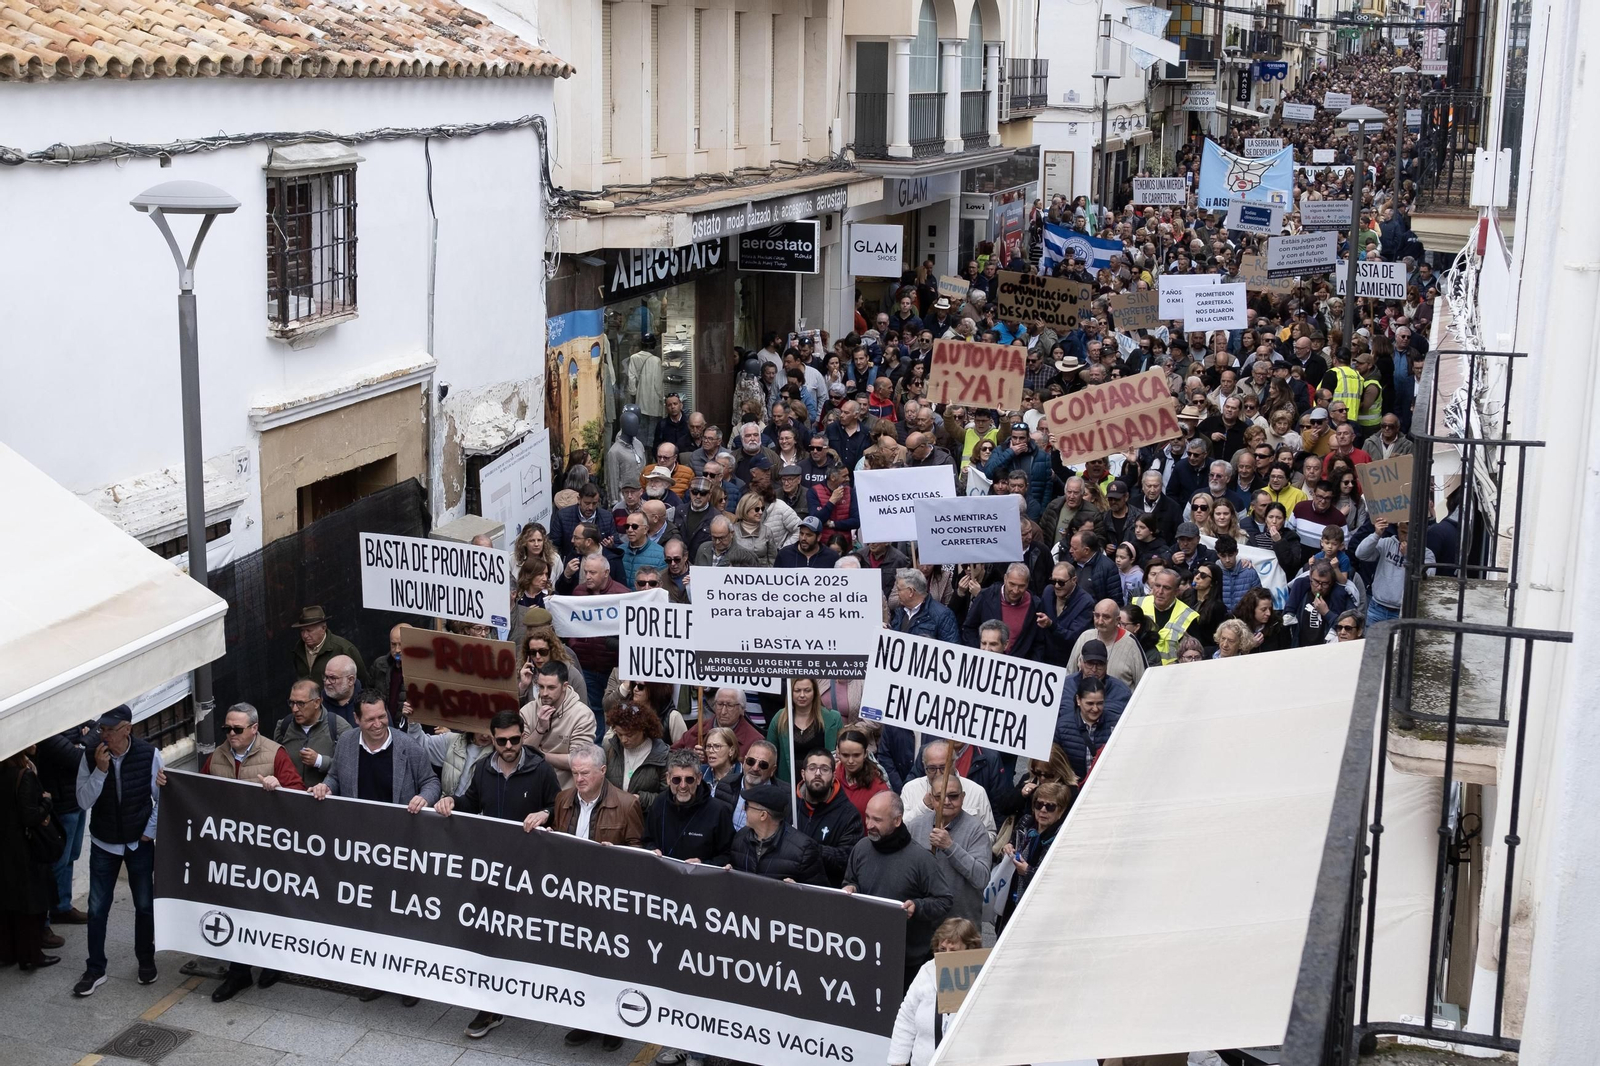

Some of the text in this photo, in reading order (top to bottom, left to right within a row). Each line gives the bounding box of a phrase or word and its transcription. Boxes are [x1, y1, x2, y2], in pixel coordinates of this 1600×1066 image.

[1189, 96, 1210, 106] NIEVES
[899, 176, 928, 207] GLAM
[1156, 180, 1165, 190] UNA
[1142, 193, 1177, 203] DE CARRETERAS
[727, 212, 744, 230] moda
[747, 207, 770, 226] calzado
[772, 206, 779, 222] &
[781, 200, 812, 216] accesorios
[816, 188, 847, 210] aerostato
[742, 238, 812, 251] aerostato
[854, 240, 897, 254] GLAM
[1301, 236, 1326, 244] jugando
[1356, 263, 1394, 279] ASTA DE
[1019, 274, 1046, 288] SIN
[1339, 280, 1404, 298] ALAMIENTO
[1014, 295, 1060, 312] NO HAY
[1128, 293, 1149, 305] SIN
[1000, 306, 1076, 327] DESARROLLO
[1113, 306, 1159, 318] CARRETER
[1122, 316, 1138, 326] DEL
[1050, 376, 1170, 424] COMARCA
[1368, 462, 1399, 485] SIN
[869, 493, 900, 503] MENOS
[879, 506, 897, 515] MÁS
[934, 513, 998, 523] LAS MENTIRAS
[931, 525, 1006, 535] NO CONSTRUYEN
[941, 537, 998, 546] CARRETERAS
[365, 537, 505, 585] BASTA DE PROMESAS
[724, 572, 849, 586] ANDALUCÍA 2025
[390, 578, 484, 620] INCUMPLIDAS
[706, 590, 868, 603] 5 horas de coche al día
[711, 607, 864, 620] para trabajar a 45 km.
[625, 606, 660, 638] POR
[665, 608, 681, 639] EL
[754, 638, 824, 650] BASTA YA
[630, 646, 714, 682] NUESTR
[707, 657, 752, 665] ARREGLO
[758, 659, 802, 667] URGENTE
[766, 667, 819, 676] CARRETERAS
[827, 668, 862, 676] AUTOVÍA
[874, 634, 1058, 707] NO MAS MUERTOS
[885, 683, 1028, 750] EN CARRETERA
[200, 816, 326, 856] ARREGLO
[334, 838, 464, 879] URGENTE
[470, 858, 504, 887] DE
[505, 865, 533, 895] LA
[541, 874, 697, 929] CARRETERA
[705, 908, 760, 941] SAN
[770, 920, 866, 962] PEDRO
[208, 861, 320, 900] MEJORA
[337, 881, 373, 908] DE
[390, 889, 441, 920] LAS
[458, 902, 630, 959] CARRETERAS
[648, 939, 662, 964] Y
[678, 948, 802, 995] AUTOVÍA
[819, 976, 856, 1006] YA
[238, 927, 854, 1063] INVERSIÓN EN INFRAESTRUCTURAS PROMESAS VACÍAS
